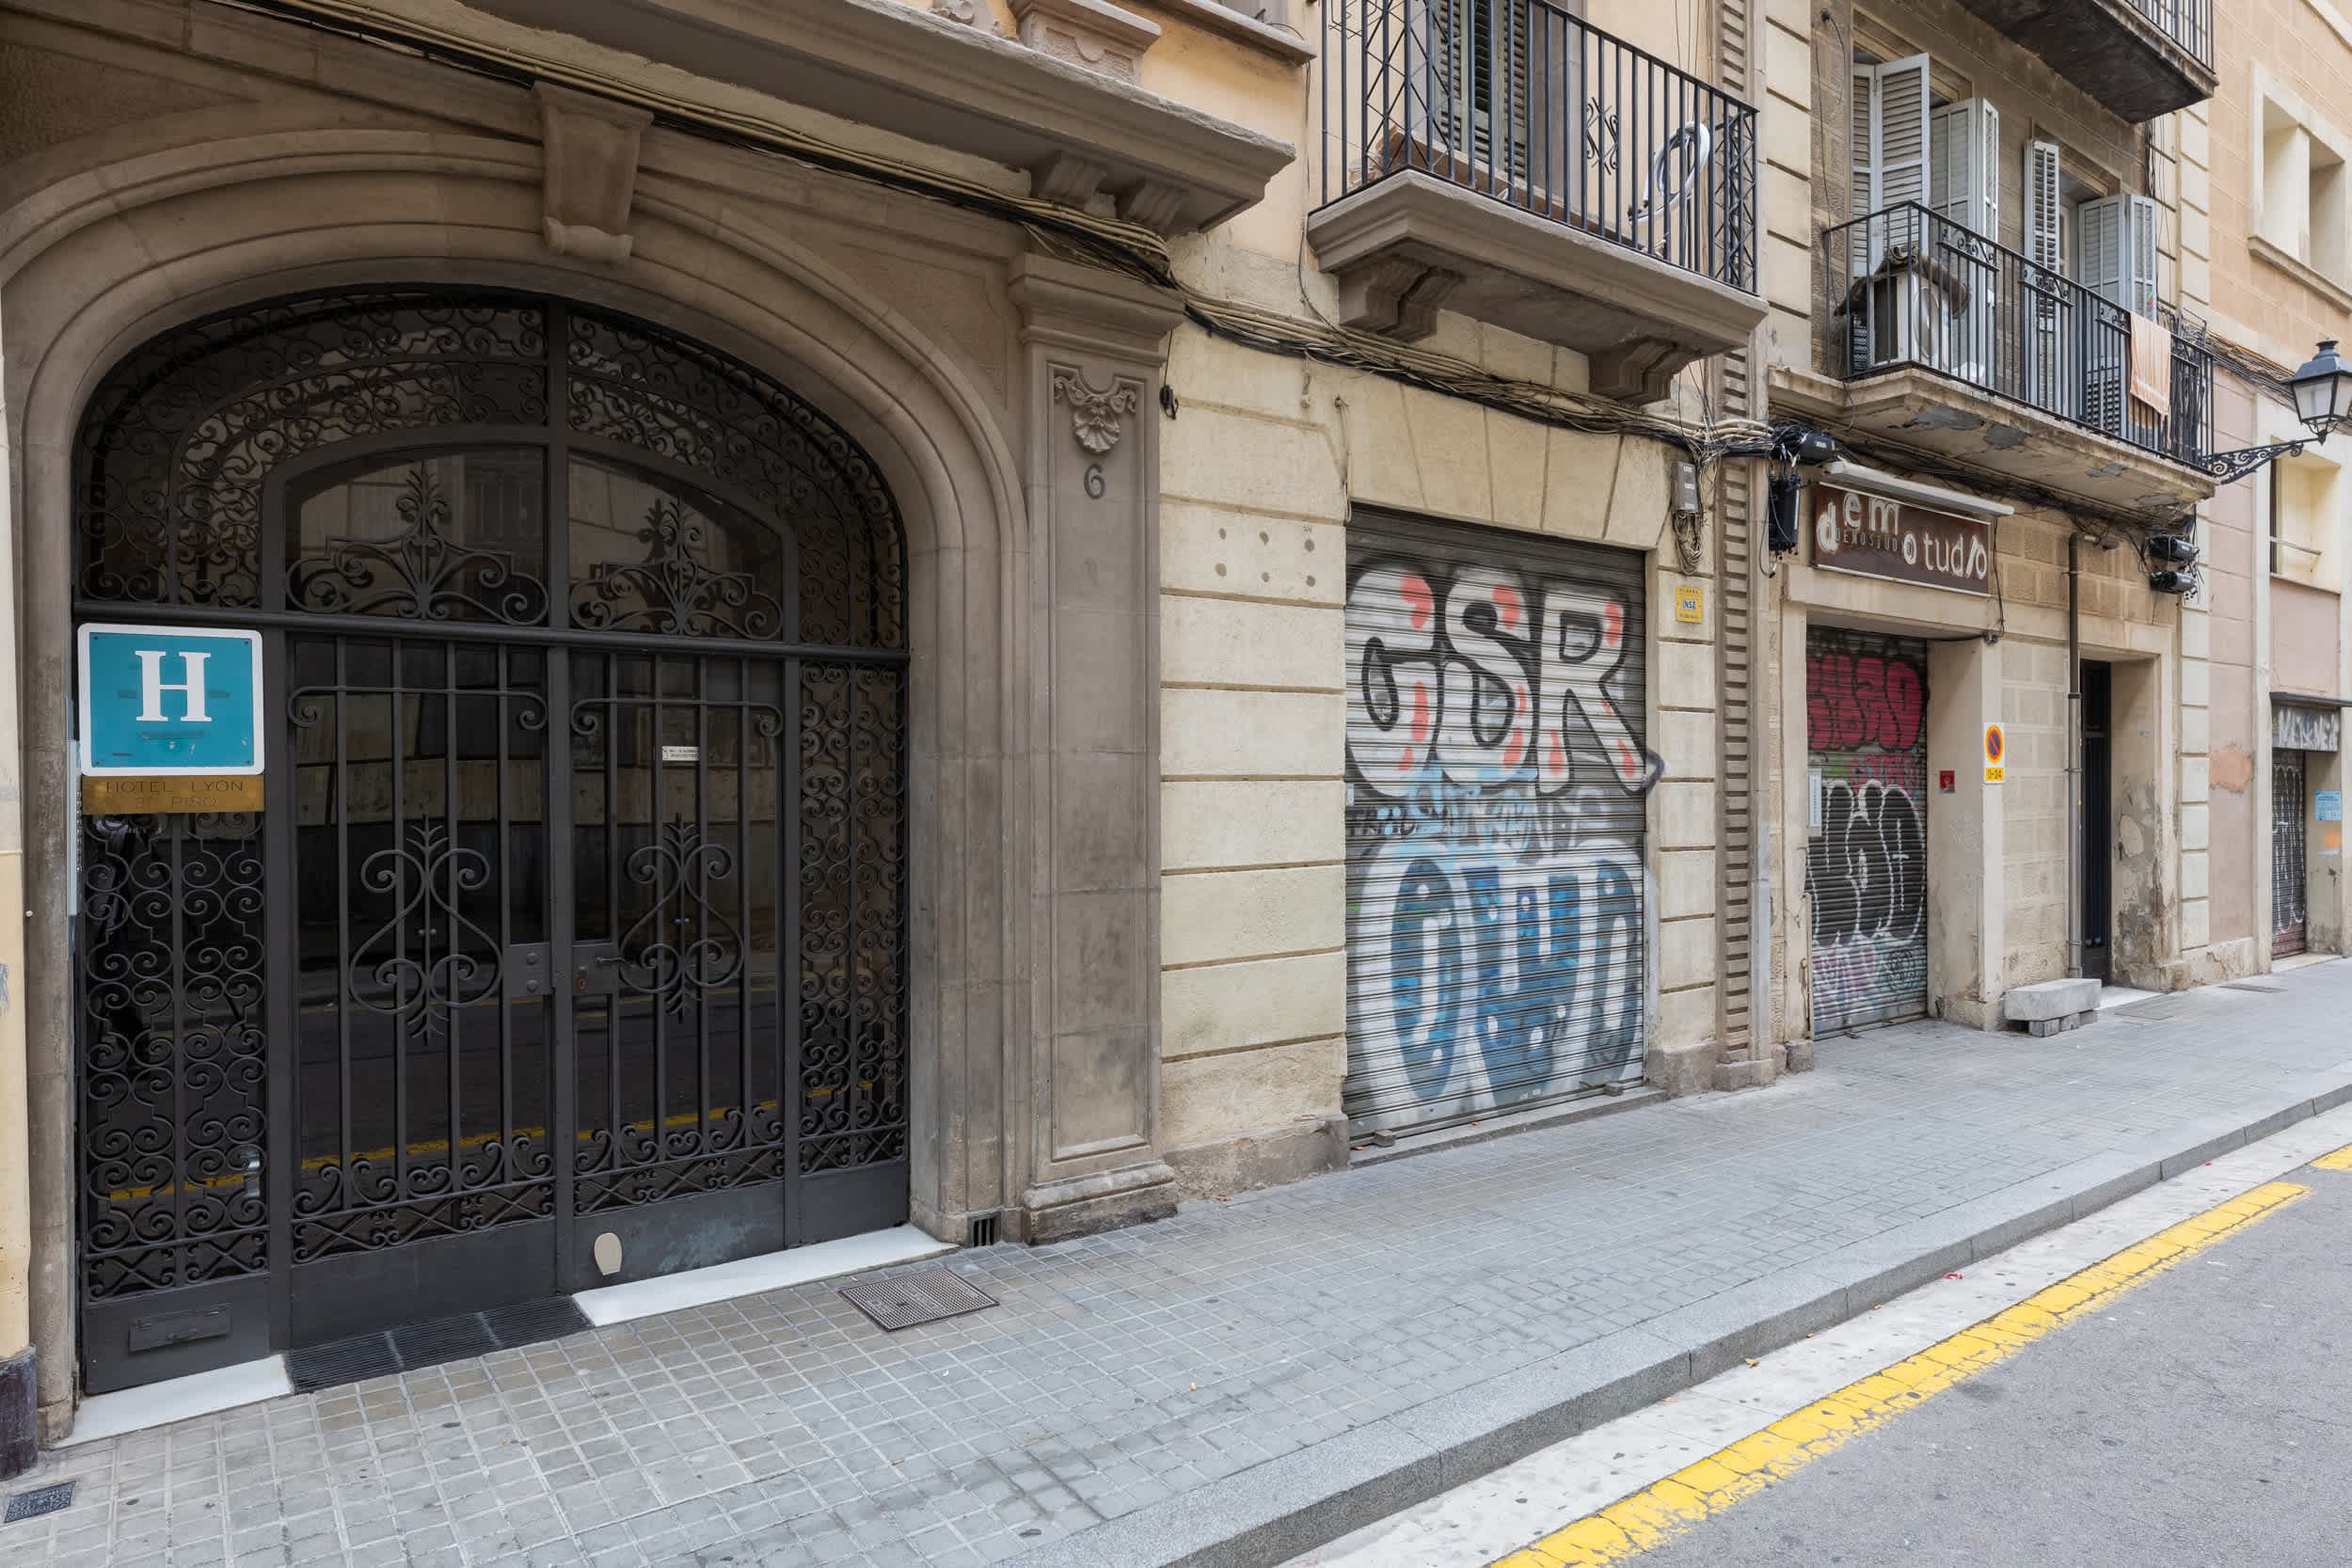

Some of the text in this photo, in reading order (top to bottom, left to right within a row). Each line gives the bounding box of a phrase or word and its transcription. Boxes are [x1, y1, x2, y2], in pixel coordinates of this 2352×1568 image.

[1083, 464, 1106, 499] 6
[135, 650, 213, 722] H
[105, 780, 245, 793] HOTEL LYON
